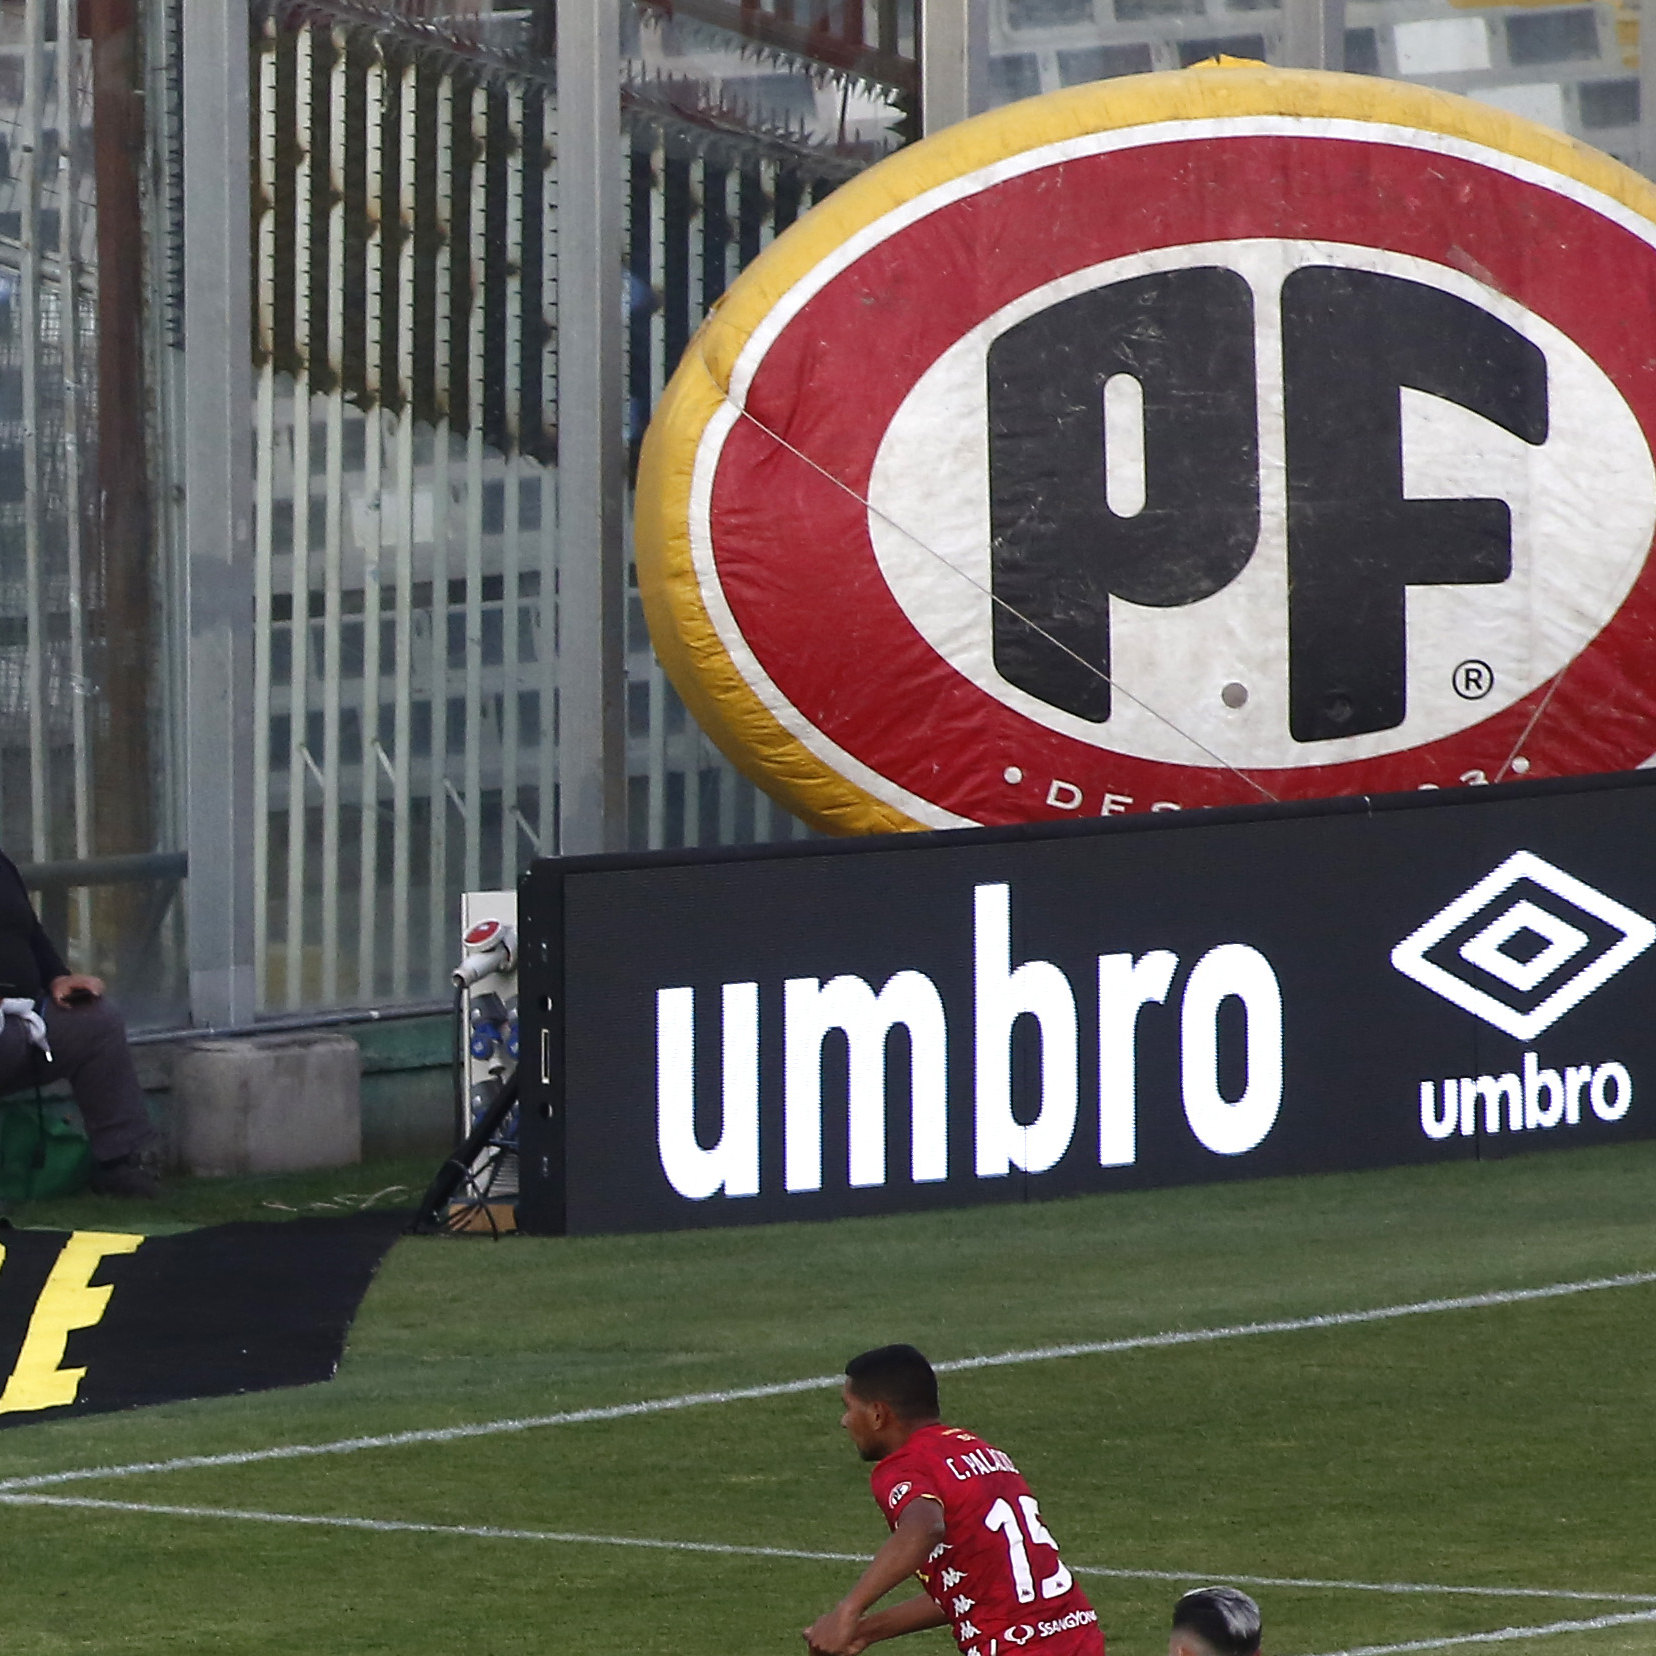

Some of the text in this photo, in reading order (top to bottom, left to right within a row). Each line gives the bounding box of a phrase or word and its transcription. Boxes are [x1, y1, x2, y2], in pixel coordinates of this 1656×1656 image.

[986, 264, 1549, 743] PF
[655, 881, 1284, 1199] umbro
[1419, 1051, 1632, 1140] umbro
[984, 1495, 1073, 1604] 15
[1037, 1609, 1098, 1637] SSANGYON
